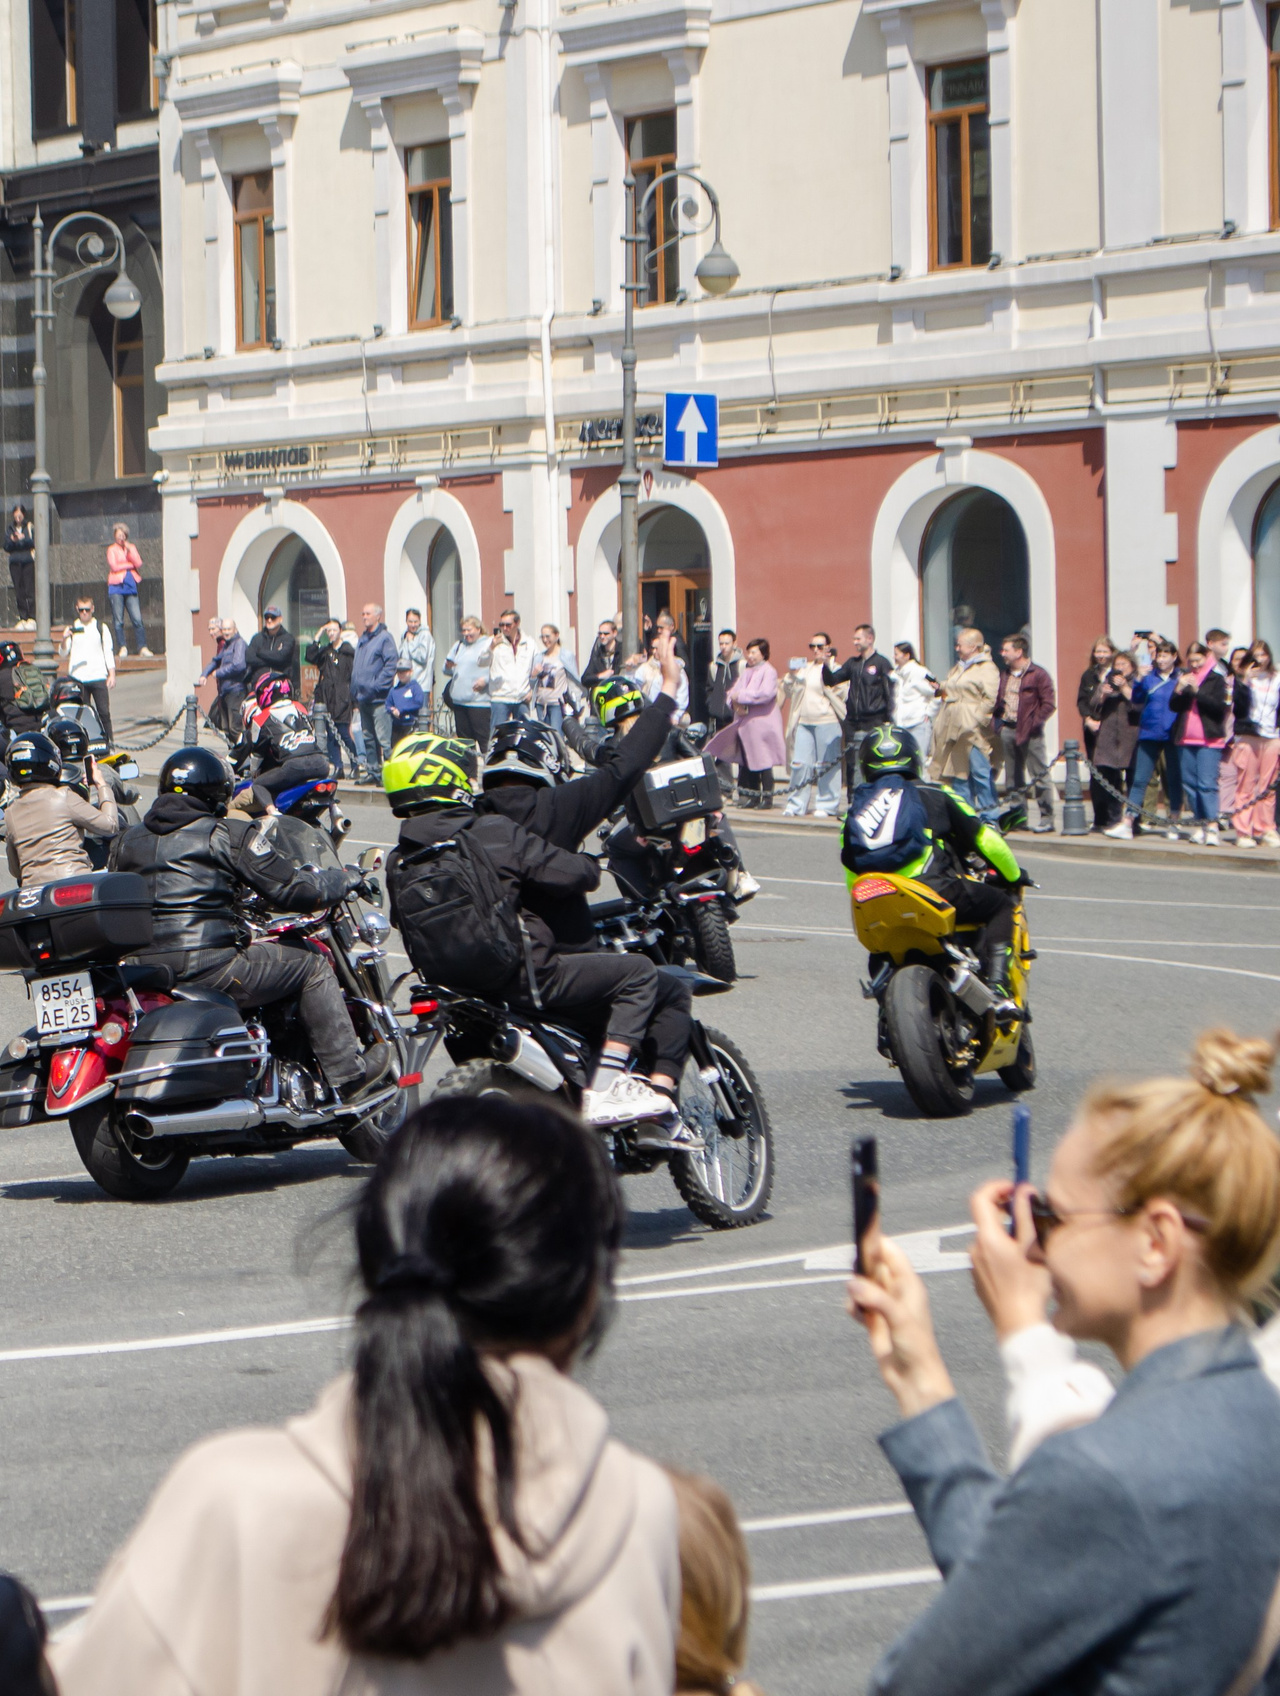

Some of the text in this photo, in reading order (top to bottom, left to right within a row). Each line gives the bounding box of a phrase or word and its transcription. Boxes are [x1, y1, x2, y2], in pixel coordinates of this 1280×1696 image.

[855, 788, 895, 838] NIKE
[41, 979, 82, 1001] 8554
[64, 998, 81, 1007] RUS
[70, 1004, 91, 1024] 25
